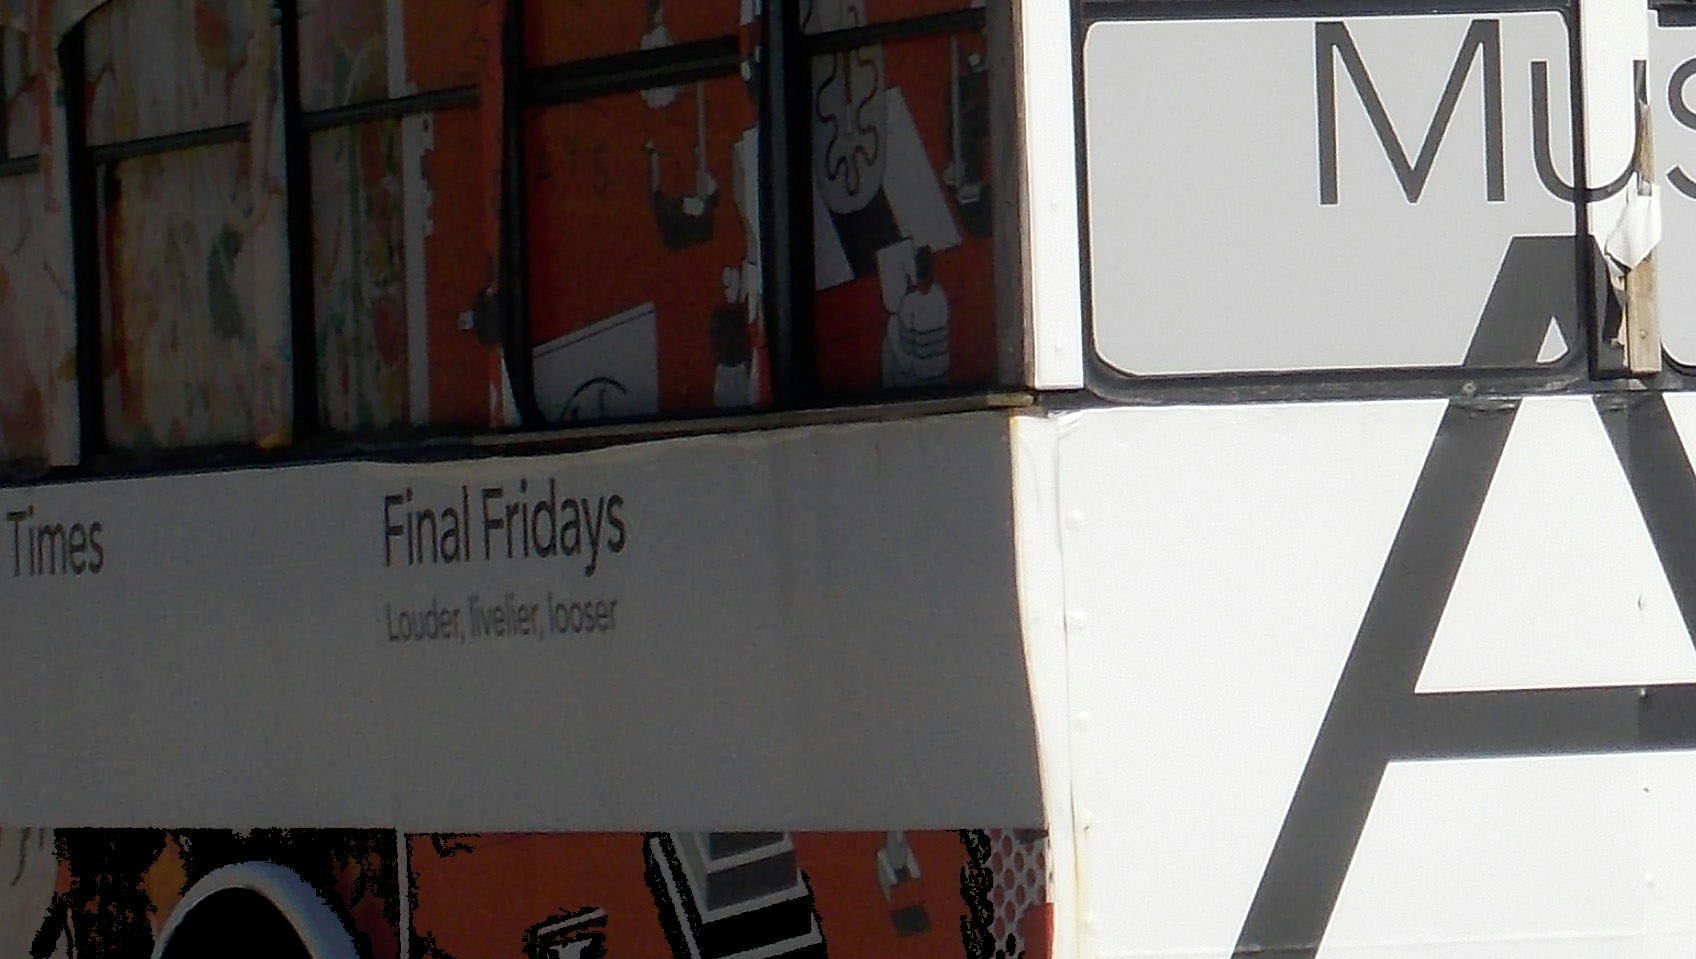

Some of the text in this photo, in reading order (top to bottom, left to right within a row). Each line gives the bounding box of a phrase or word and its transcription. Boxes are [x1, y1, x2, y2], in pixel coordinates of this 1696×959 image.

[7, 504, 104, 577] Times
[384, 477, 626, 578] Final Fridays
[385, 600, 466, 644] Louder,
[547, 590, 618, 634] looser
